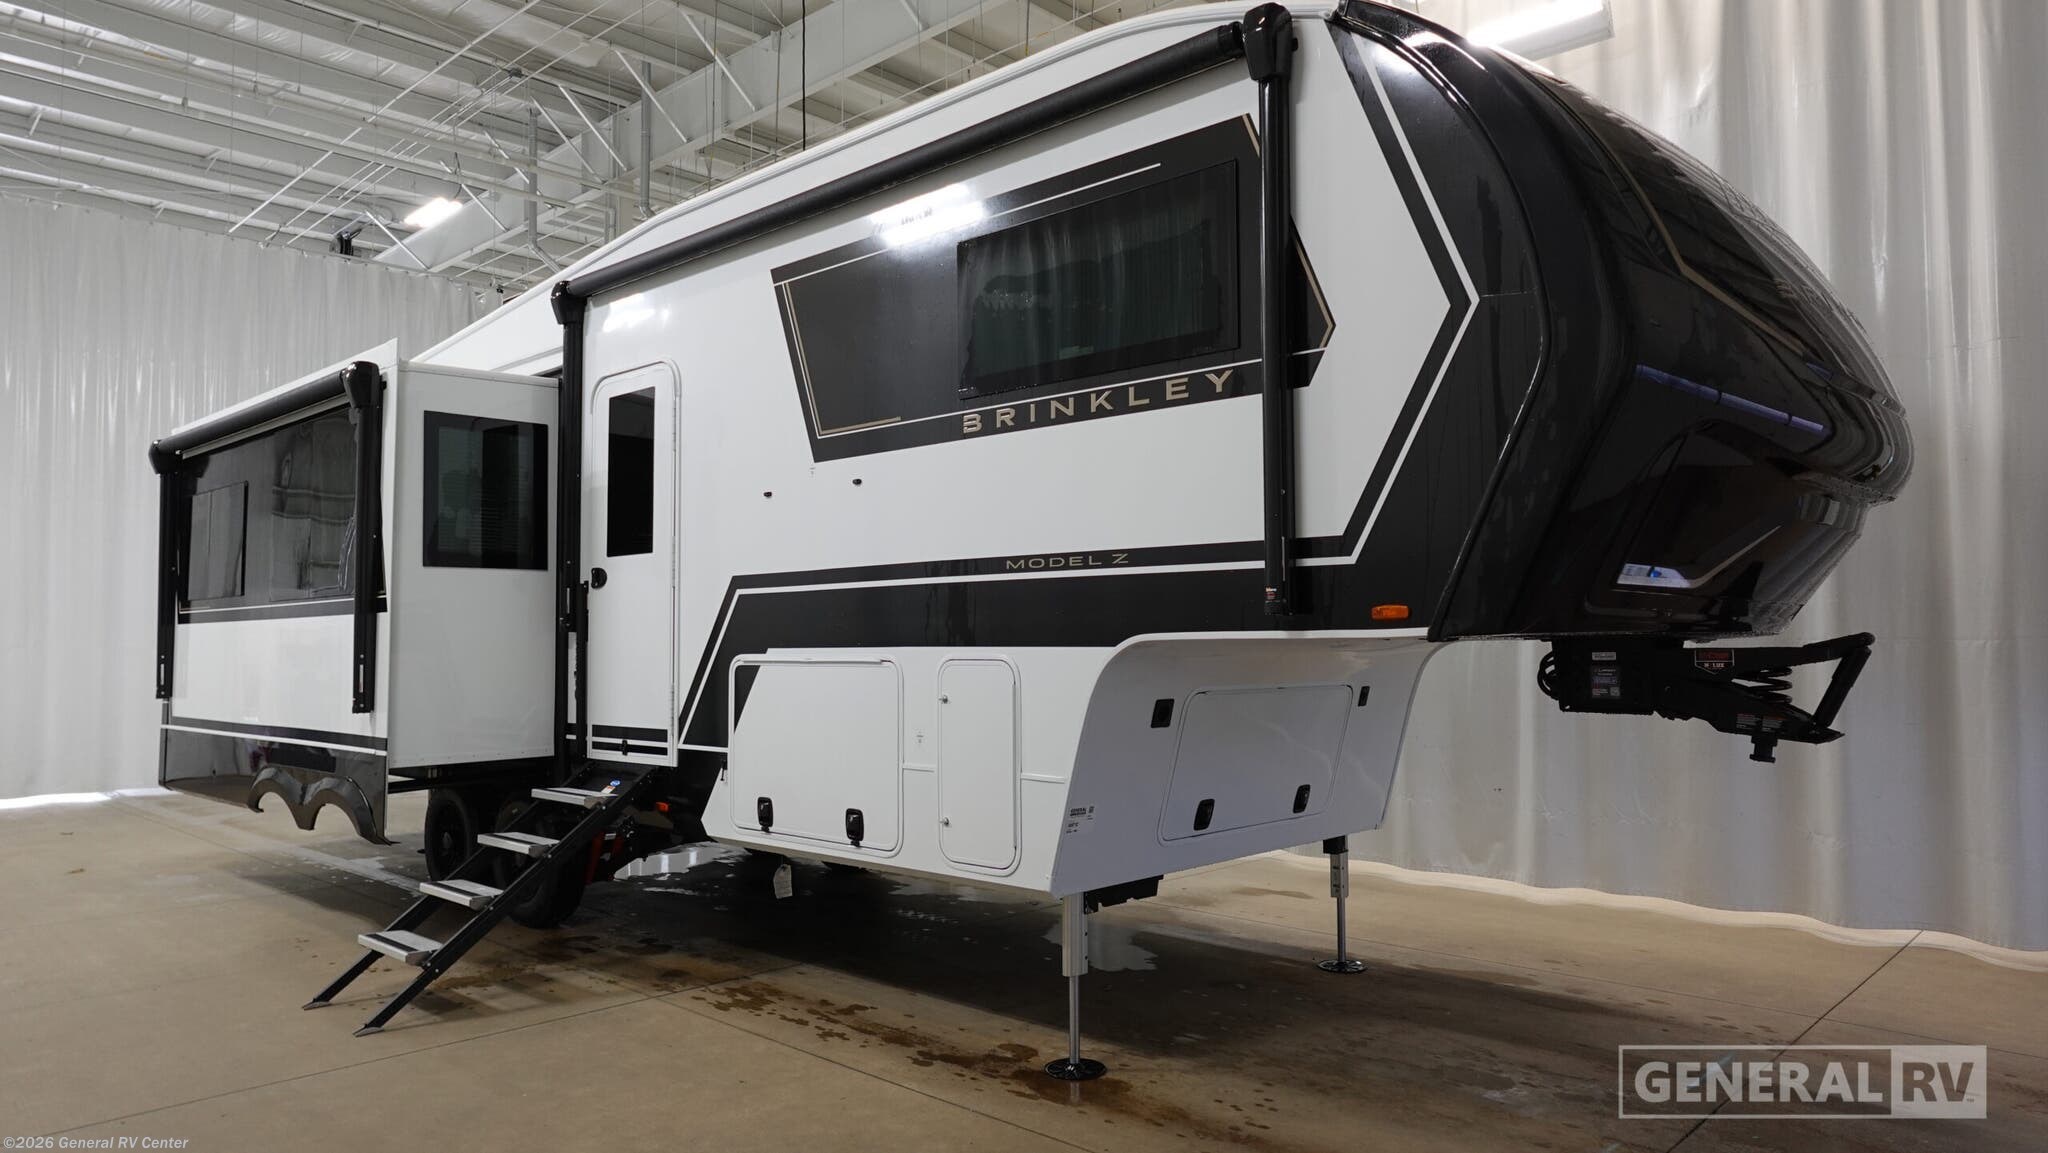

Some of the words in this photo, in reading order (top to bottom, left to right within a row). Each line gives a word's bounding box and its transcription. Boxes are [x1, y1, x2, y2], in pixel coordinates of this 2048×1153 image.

[962, 369, 1234, 433] BRINKLEY
[1006, 555, 1102, 570] MODEL
[1112, 553, 1129, 564] Z
